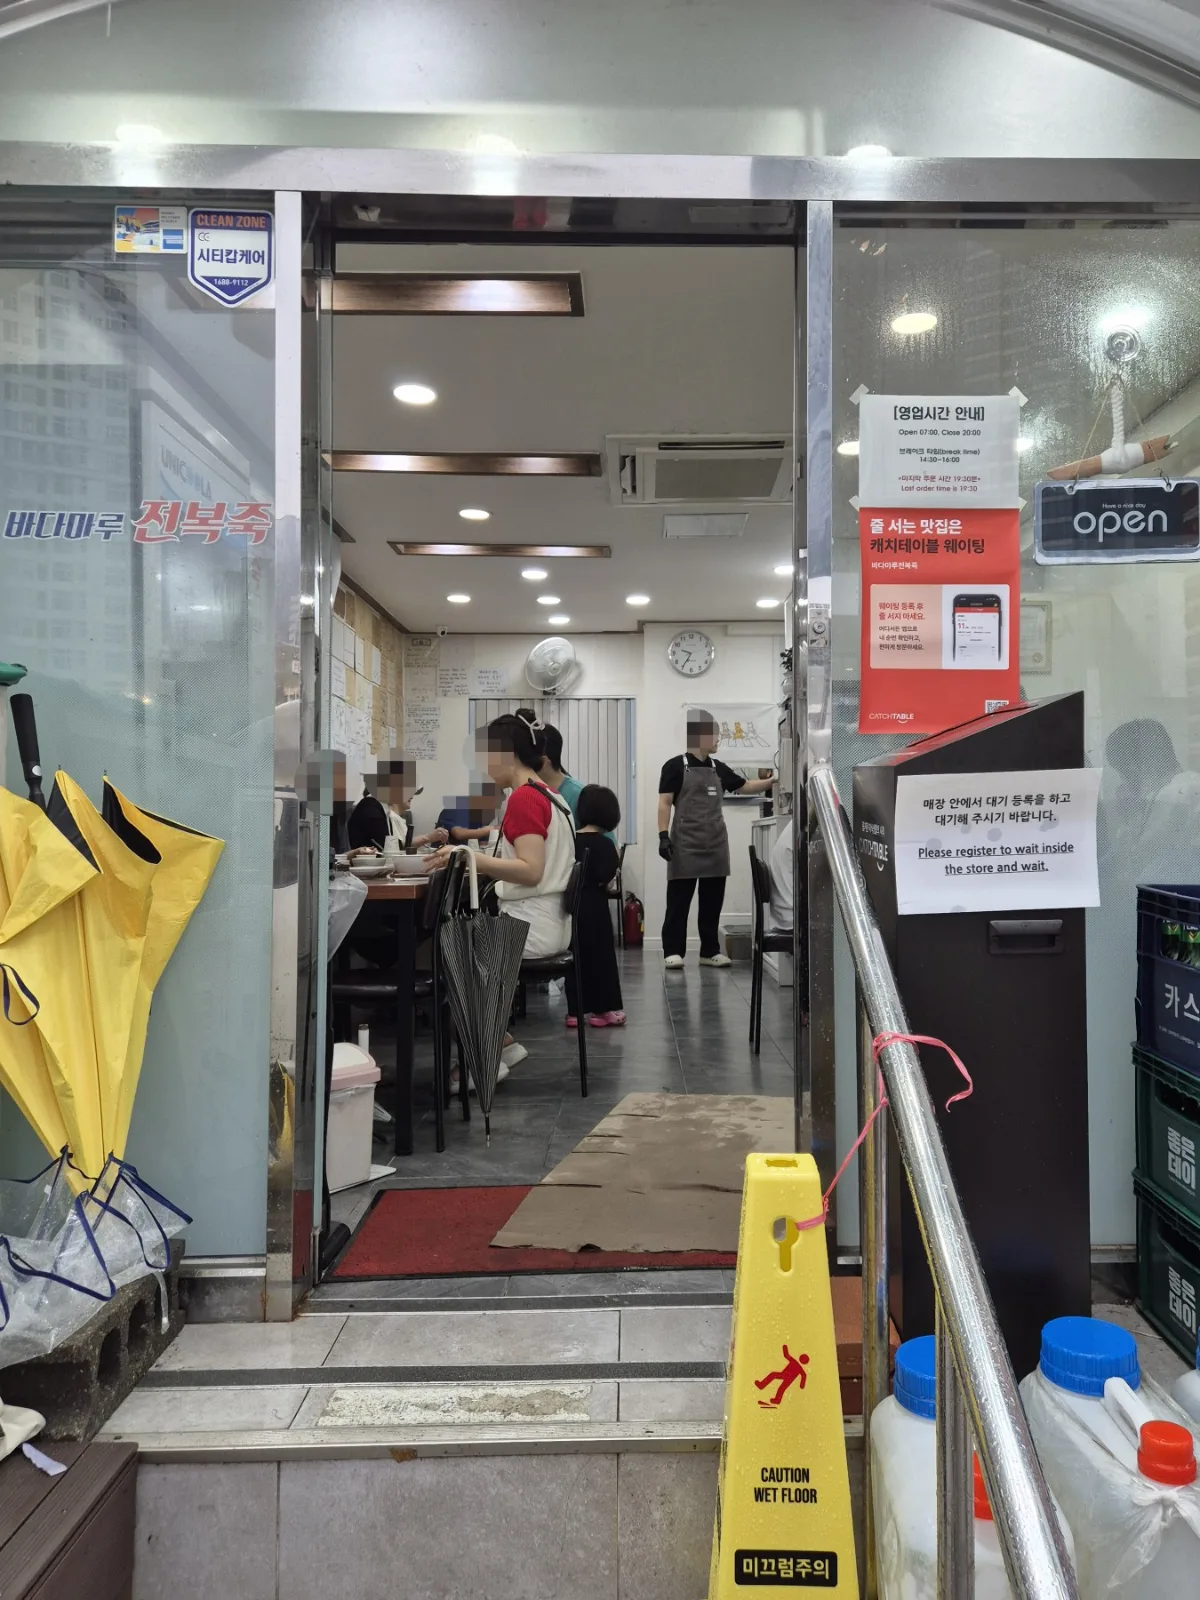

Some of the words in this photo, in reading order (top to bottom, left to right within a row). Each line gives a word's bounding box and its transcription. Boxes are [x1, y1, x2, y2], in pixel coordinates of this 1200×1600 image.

[196, 214, 233, 227] CLEAN
[236, 216, 266, 228] ZONE
[197, 248, 265, 265] 시티캅케어
[214, 278, 249, 286] 1688-9112
[893, 405, 950, 421] [영업시간
[955, 405, 985, 421] 안내]
[898, 429, 918, 437] Open
[3, 509, 127, 543] 바다마루
[131, 499, 274, 545] 전복죽
[870, 518, 884, 534] 줄
[888, 519, 916, 535] 서는
[920, 518, 962, 535] 맛집은
[1073, 510, 1168, 542] open
[870, 538, 939, 554] 캐치테이블
[943, 538, 985, 554] 웨이팅
[871, 562, 918, 570] 바다마루전복죽
[878, 602, 900, 610] 웨이팅
[901, 602, 915, 610] 등록
[916, 602, 924, 610] 후
[878, 612, 886, 620] 줄
[887, 612, 902, 620] 서지
[902, 612, 925, 620] 마세요.
[922, 798, 946, 811] 매장
[949, 796, 983, 809] 안에서
[986, 795, 1008, 808] 대기
[1012, 794, 1046, 806] 등록을
[1049, 793, 1071, 804] 하고
[934, 812, 968, 826] 대기해
[972, 812, 1005, 824] 주시기
[1008, 810, 1057, 823] 바랍니다.
[918, 847, 952, 858] Please
[956, 845, 996, 858] register
[1000, 845, 1012, 855] to
[1014, 844, 1040, 854] wait
[1042, 842, 1074, 854] inside
[945, 864, 962, 874] the
[966, 863, 994, 874] store
[996, 860, 1018, 872] and
[1021, 860, 1049, 872] wait.
[1164, 983, 1200, 1022] 카스
[1167, 1126, 1196, 1165] 좋은
[1167, 1151, 1196, 1190] 데이
[1168, 1266, 1196, 1303] 좋은
[1168, 1292, 1197, 1333] 데이
[761, 1467, 810, 1483] CAUTION
[754, 1488, 778, 1502] WET
[782, 1488, 818, 1504] FLOOR
[742, 1557, 830, 1580] 미끄럼주의
